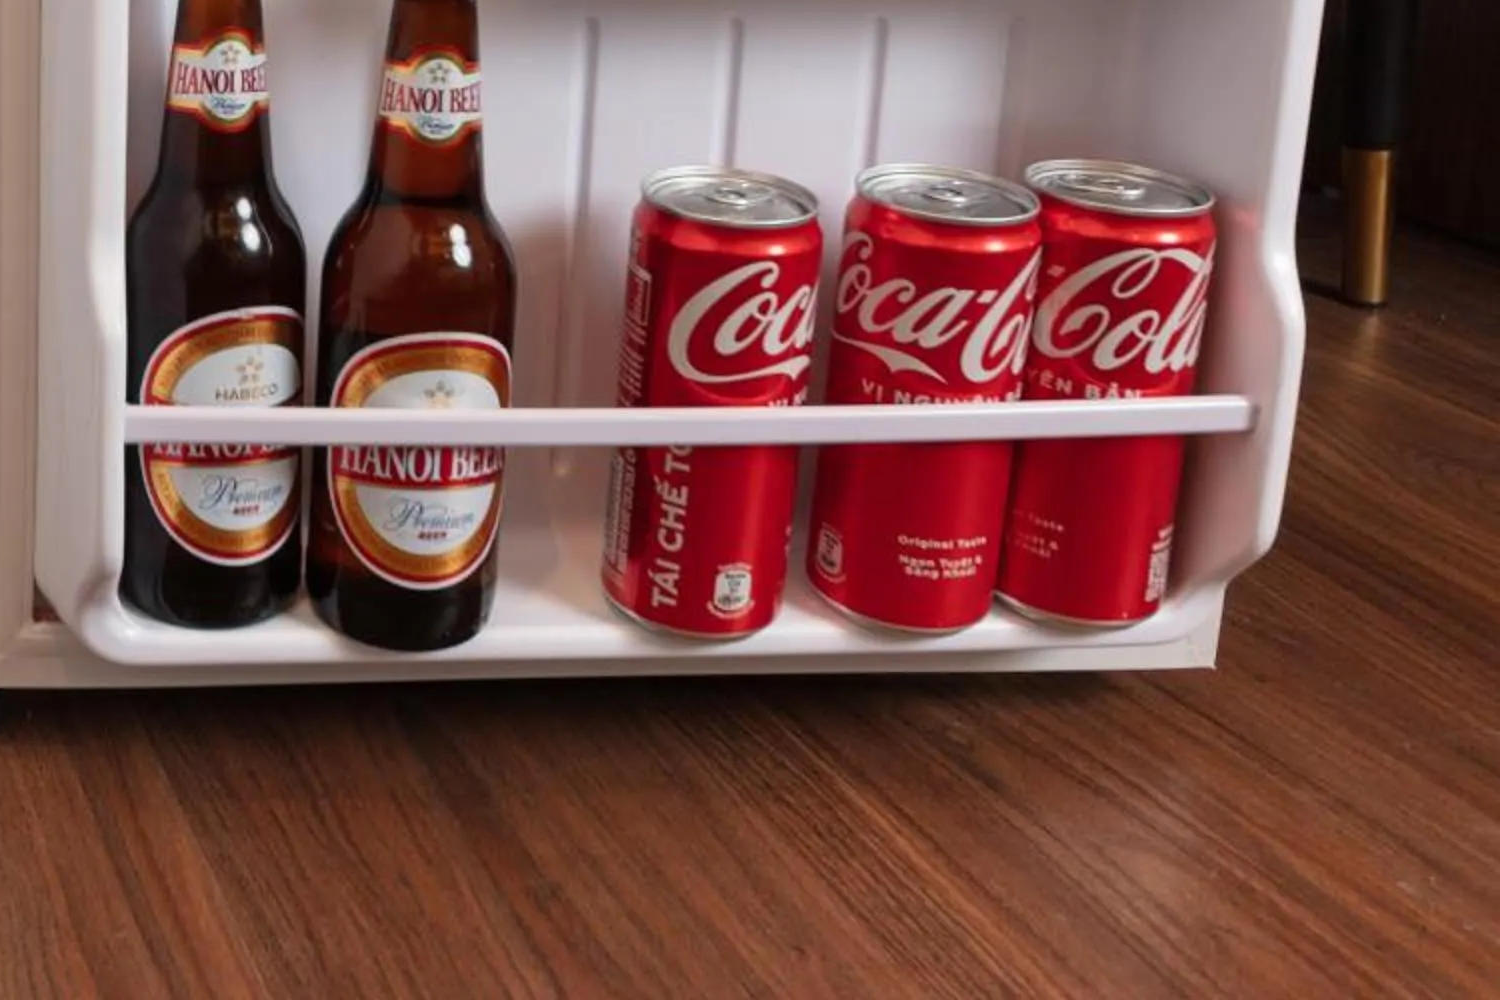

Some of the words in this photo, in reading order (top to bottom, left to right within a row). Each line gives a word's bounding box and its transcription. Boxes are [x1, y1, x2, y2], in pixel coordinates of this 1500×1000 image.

[175, 61, 236, 94] HANOI
[382, 78, 443, 112] HANOI
[653, 475, 689, 553] CHẾ
[647, 558, 681, 607] TÁI
